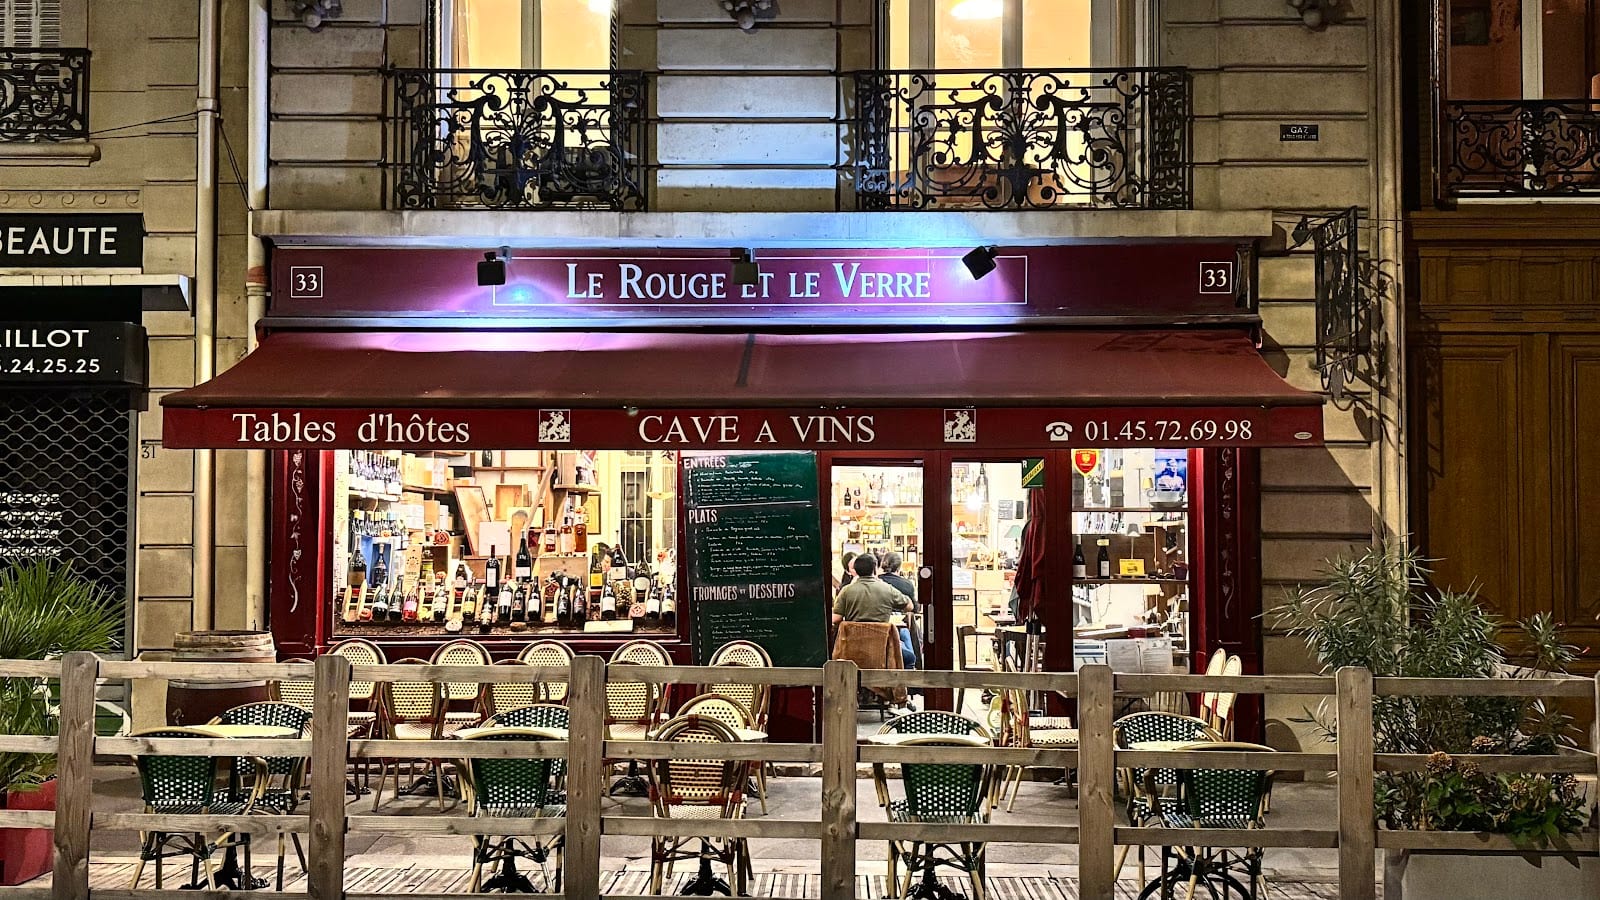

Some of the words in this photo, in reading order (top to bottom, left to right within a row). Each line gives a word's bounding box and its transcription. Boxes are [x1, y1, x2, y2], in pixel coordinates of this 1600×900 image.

[1290, 126, 1309, 134] GAZ
[0, 227, 118, 255] EAUTE
[296, 273, 318, 292] 33
[565, 263, 604, 299] LE
[618, 263, 727, 299] ROUGE
[788, 272, 820, 298] LE
[832, 262, 931, 298] VERRE
[1204, 269, 1227, 287] 33
[0, 329, 90, 348] ILLOT
[0, 358, 100, 374] .24.25.25
[232, 412, 336, 443] Tables
[357, 413, 470, 443] d'hôtes
[638, 415, 740, 443] CAVE
[754, 420, 778, 443] A
[789, 415, 875, 443] VINS
[1084, 419, 1253, 441] 01.45.72.69.98
[141, 446, 156, 459] 31
[688, 508, 718, 524] PLATS
[693, 585, 738, 601] FROMAGES
[748, 583, 795, 599] DESSERTS
